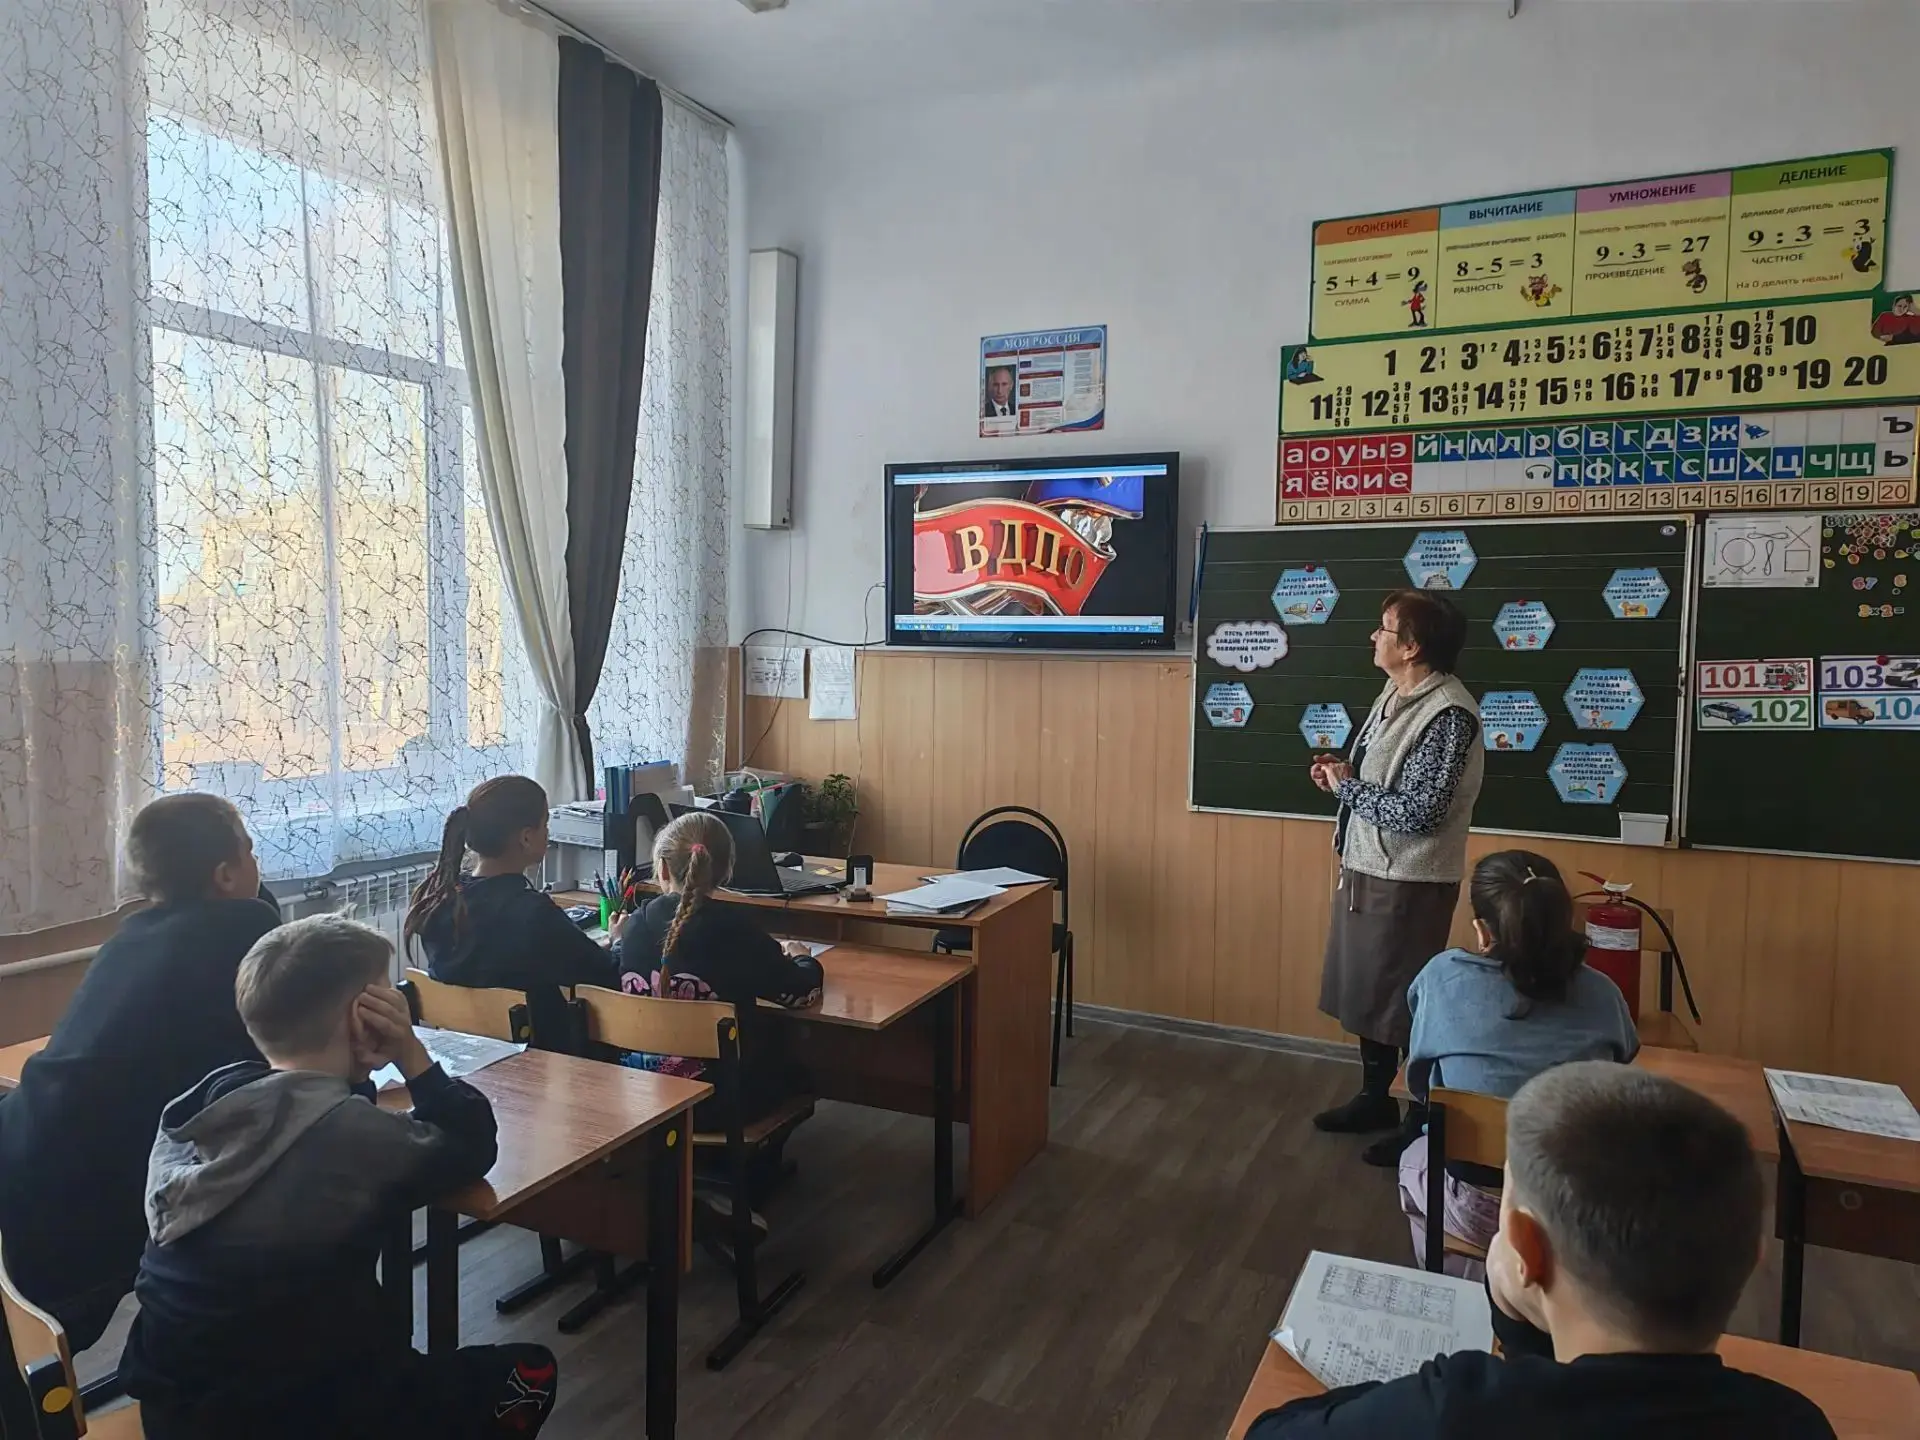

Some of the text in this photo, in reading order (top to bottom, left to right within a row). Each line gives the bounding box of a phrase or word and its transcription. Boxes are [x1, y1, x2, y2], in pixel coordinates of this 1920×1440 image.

[1779, 165, 1847, 184] ДЕЛЕНИЕ
[1609, 184, 1696, 203] УМНОЖЕНИЕ
[1469, 201, 1544, 220] ВЫЧИТАНИЕ
[1347, 219, 1410, 236] СЛОЖЕНИЕ
[1748, 229, 1764, 247] 9
[1795, 224, 1812, 243] 3
[1853, 218, 1870, 237] 3
[1596, 245, 1609, 261] 9
[1632, 242, 1645, 259] 3
[1681, 235, 1710, 254] 27
[1457, 260, 1469, 277] 8
[1490, 256, 1503, 273] 5
[1531, 252, 1543, 269] 3
[1752, 253, 1804, 265] ЧАСТНОЕ
[1326, 275, 1338, 292] 5
[1366, 271, 1379, 287] 4
[1408, 266, 1420, 282] 9
[1585, 266, 1665, 281] ПРОИЗВЕДЕНИЕ
[1453, 283, 1503, 295] РАЗНОСТЬ
[1761, 278, 1799, 289] делить
[1334, 297, 1370, 307] СУММА
[1004, 332, 1081, 349] МОЯ РОССИЯ
[1384, 315, 1816, 376] 1 2 3 4 5 6 7 8 9 10
[1480, 342, 1497, 353] 1 2
[1767, 365, 1787, 377] 9 9
[1310, 355, 1887, 420] 11 12 13 14 15 16 17 18 19 20
[1289, 484, 1907, 518] 0 1 2 3 4 5 6 7 8 9 10 11 12 13 14 15 16 17 18 19 20
[955, 519, 1086, 592] ВДПО
[1239, 655, 1254, 663] 101
[1704, 665, 1761, 689] 101
[1825, 665, 1884, 688] 103
[1751, 700, 1808, 723] 102
